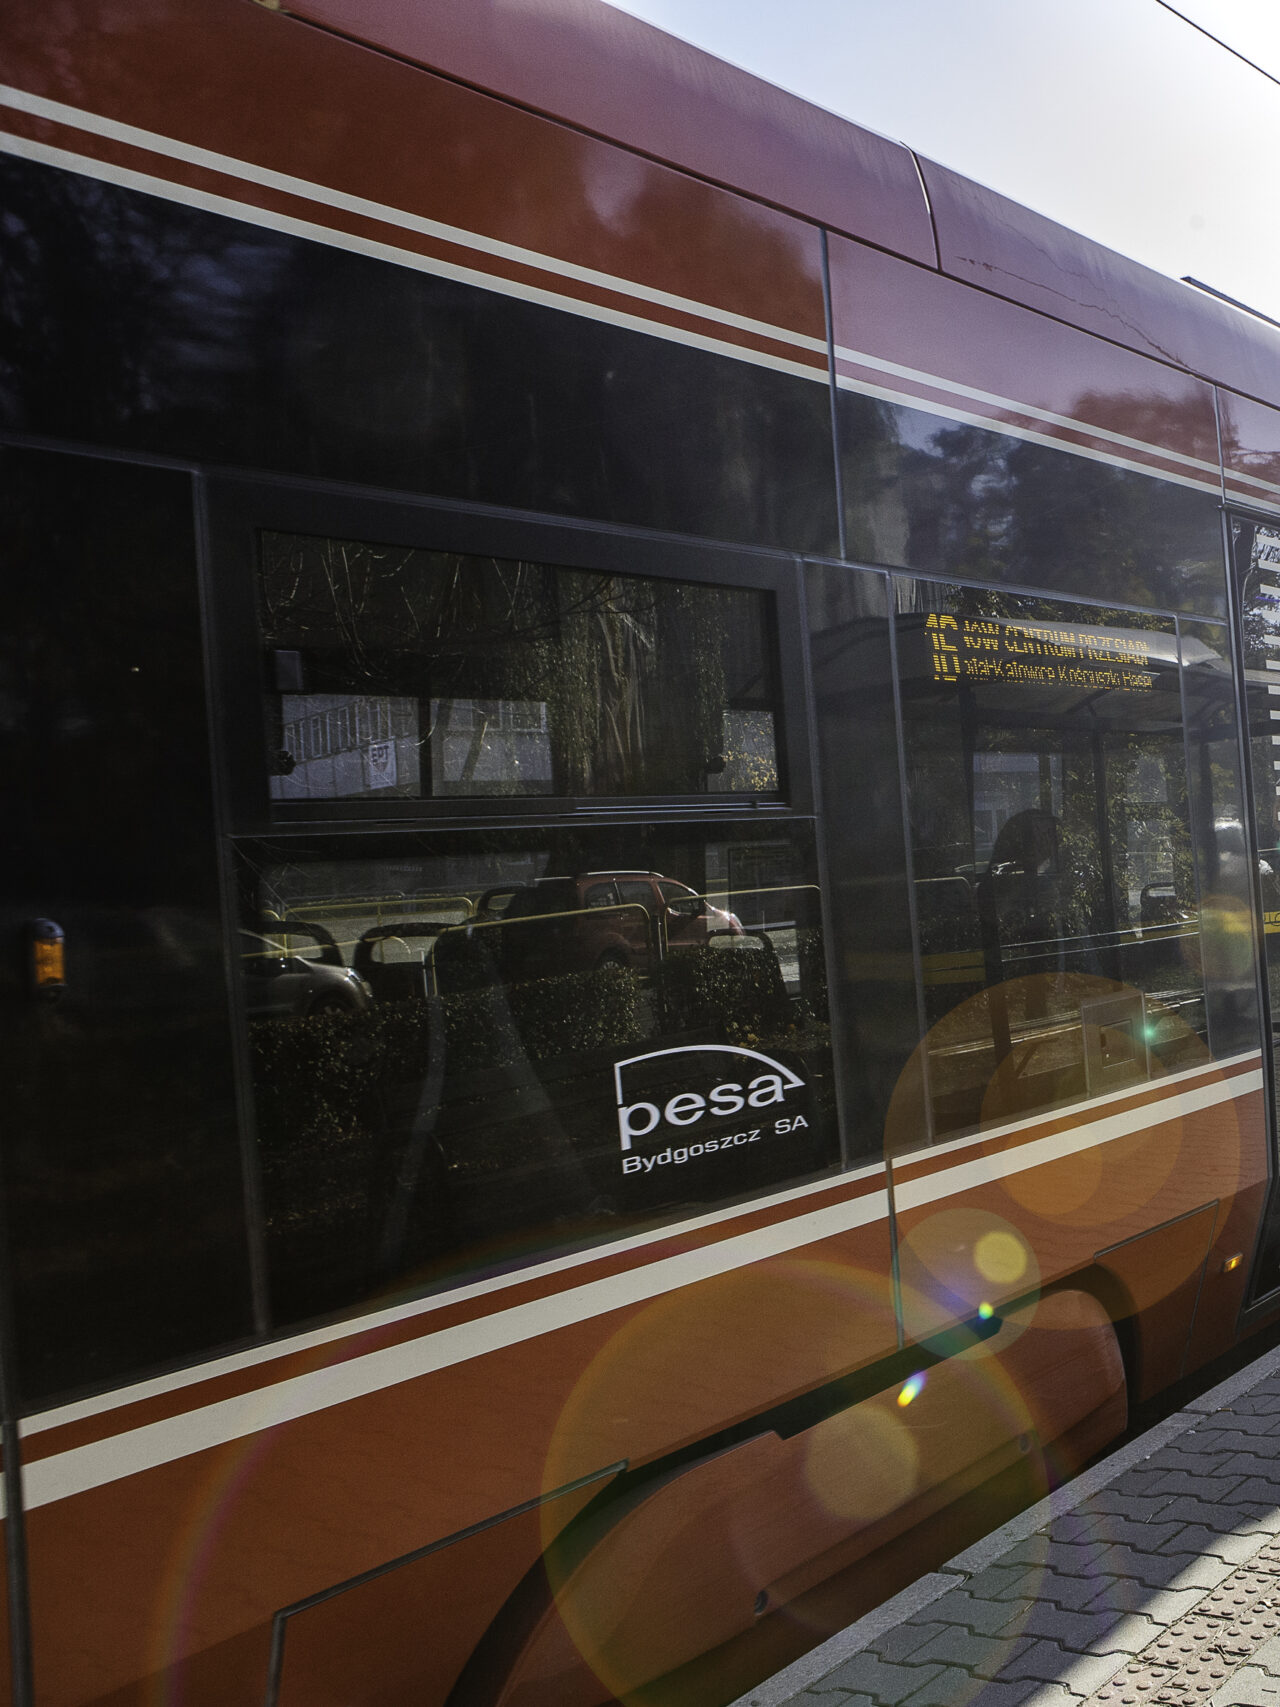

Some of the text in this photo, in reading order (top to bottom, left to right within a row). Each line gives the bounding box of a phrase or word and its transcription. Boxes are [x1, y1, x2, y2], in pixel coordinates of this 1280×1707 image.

[617, 1074, 786, 1151] pesa
[621, 1115, 809, 1175] Bydgoszcz SA
